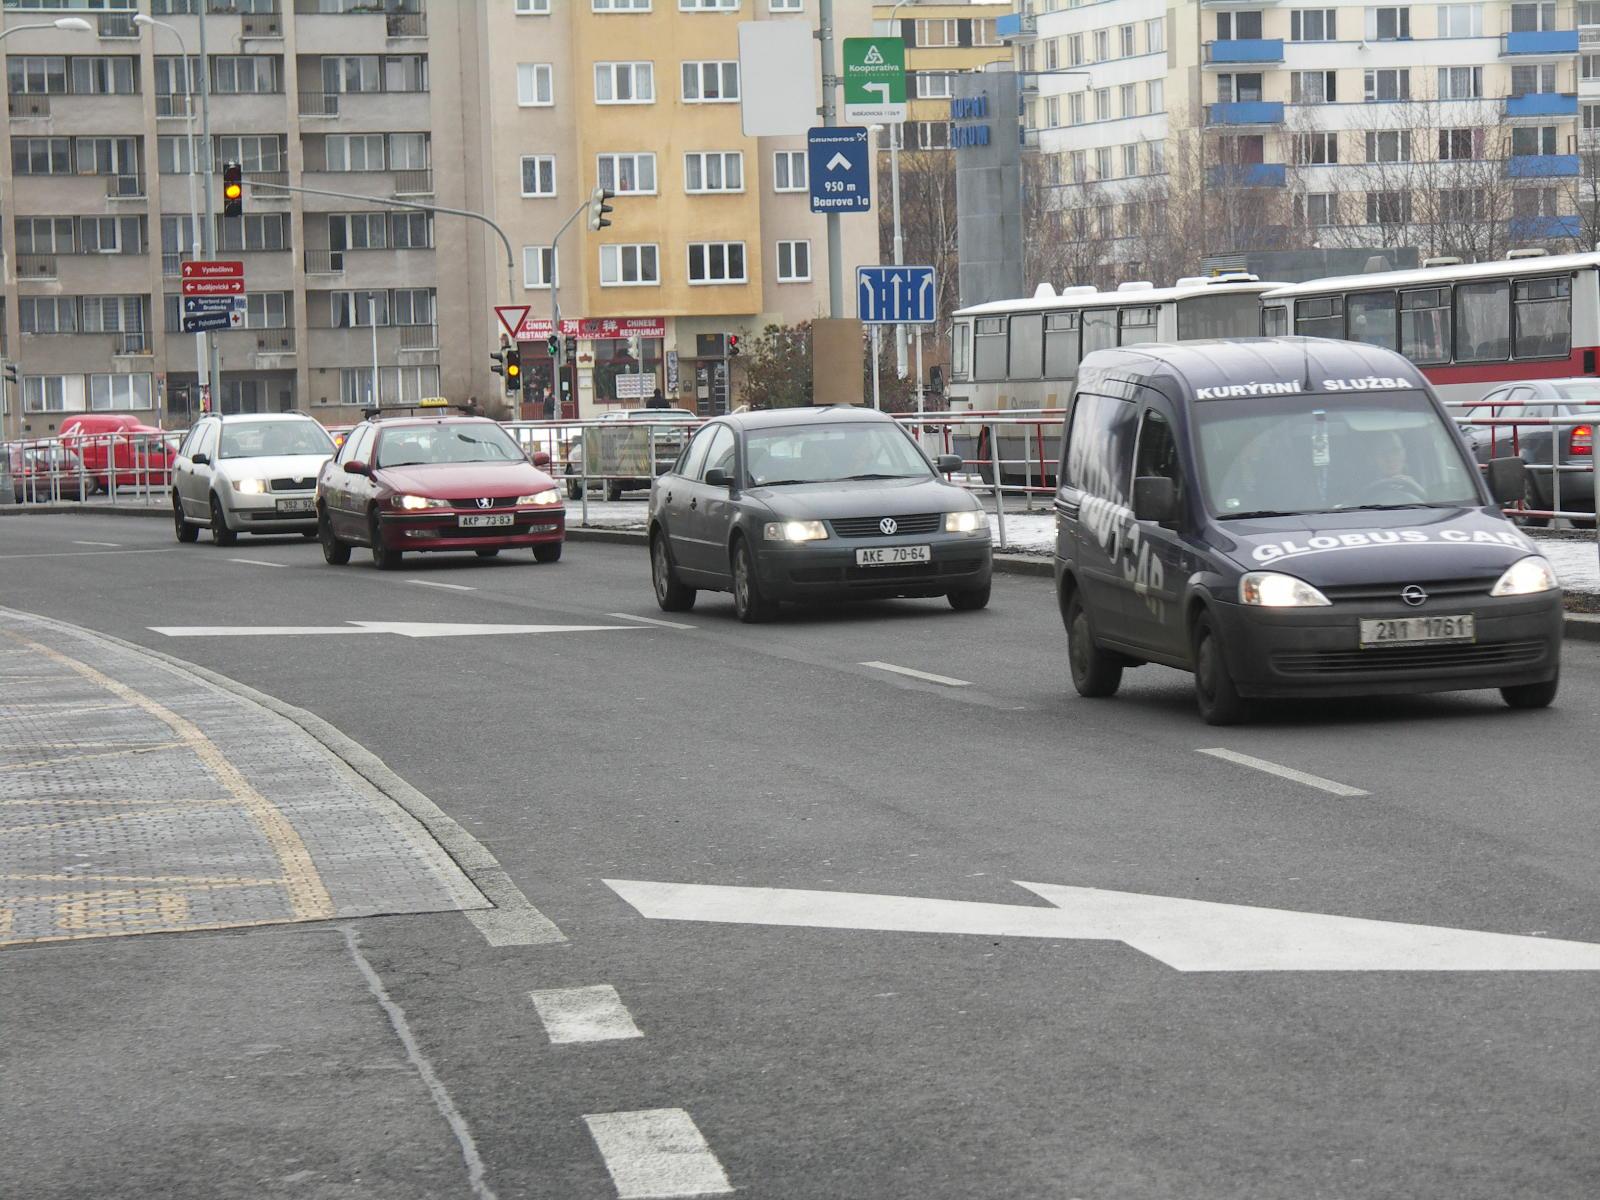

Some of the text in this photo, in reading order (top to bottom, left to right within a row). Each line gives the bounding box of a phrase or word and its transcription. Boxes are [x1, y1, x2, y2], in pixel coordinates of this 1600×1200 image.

[849, 63, 900, 73] Kooperativa
[824, 181, 856, 192] 950 m
[813, 195, 869, 207] Baarova 1a
[196, 282, 229, 292] Budějovická
[626, 319, 656, 328] CHINESE
[619, 328, 664, 337] RESTAURANT
[1196, 376, 1413, 400] KURÝRNÍ SLUŽBA
[463, 515, 511, 526] AKP 73-83
[1252, 530, 1526, 561] GLOBUS CAR
[862, 547, 925, 563] AKE 70-64
[1376, 618, 1465, 640] 2A1 1761
